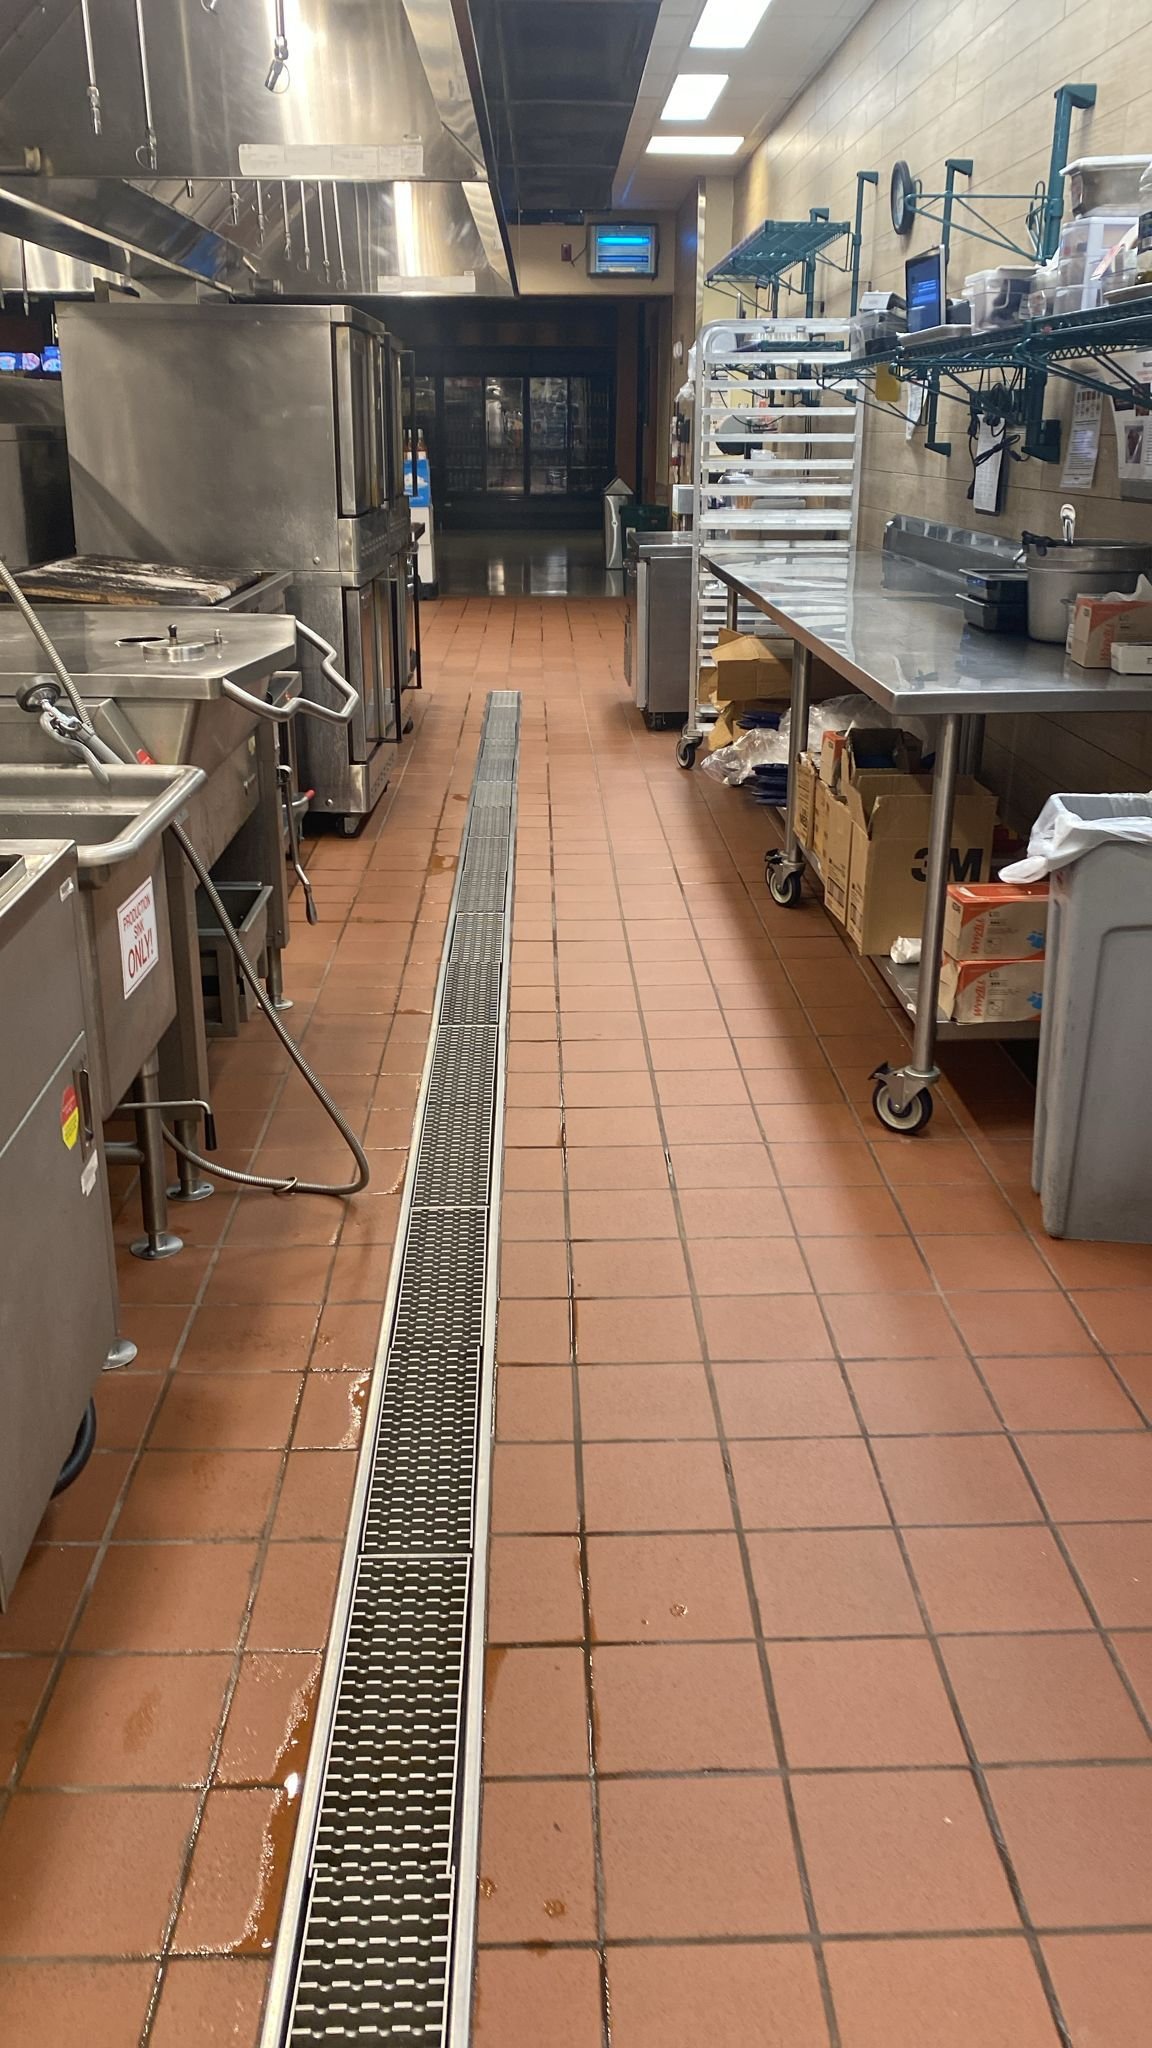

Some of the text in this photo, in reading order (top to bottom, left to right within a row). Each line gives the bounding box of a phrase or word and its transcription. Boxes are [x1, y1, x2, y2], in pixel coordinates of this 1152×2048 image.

[911, 847, 984, 883] 3M
[123, 894, 151, 931] PRODUCTION
[133, 918, 145, 939] SINK
[128, 928, 153, 978] ONLY!
